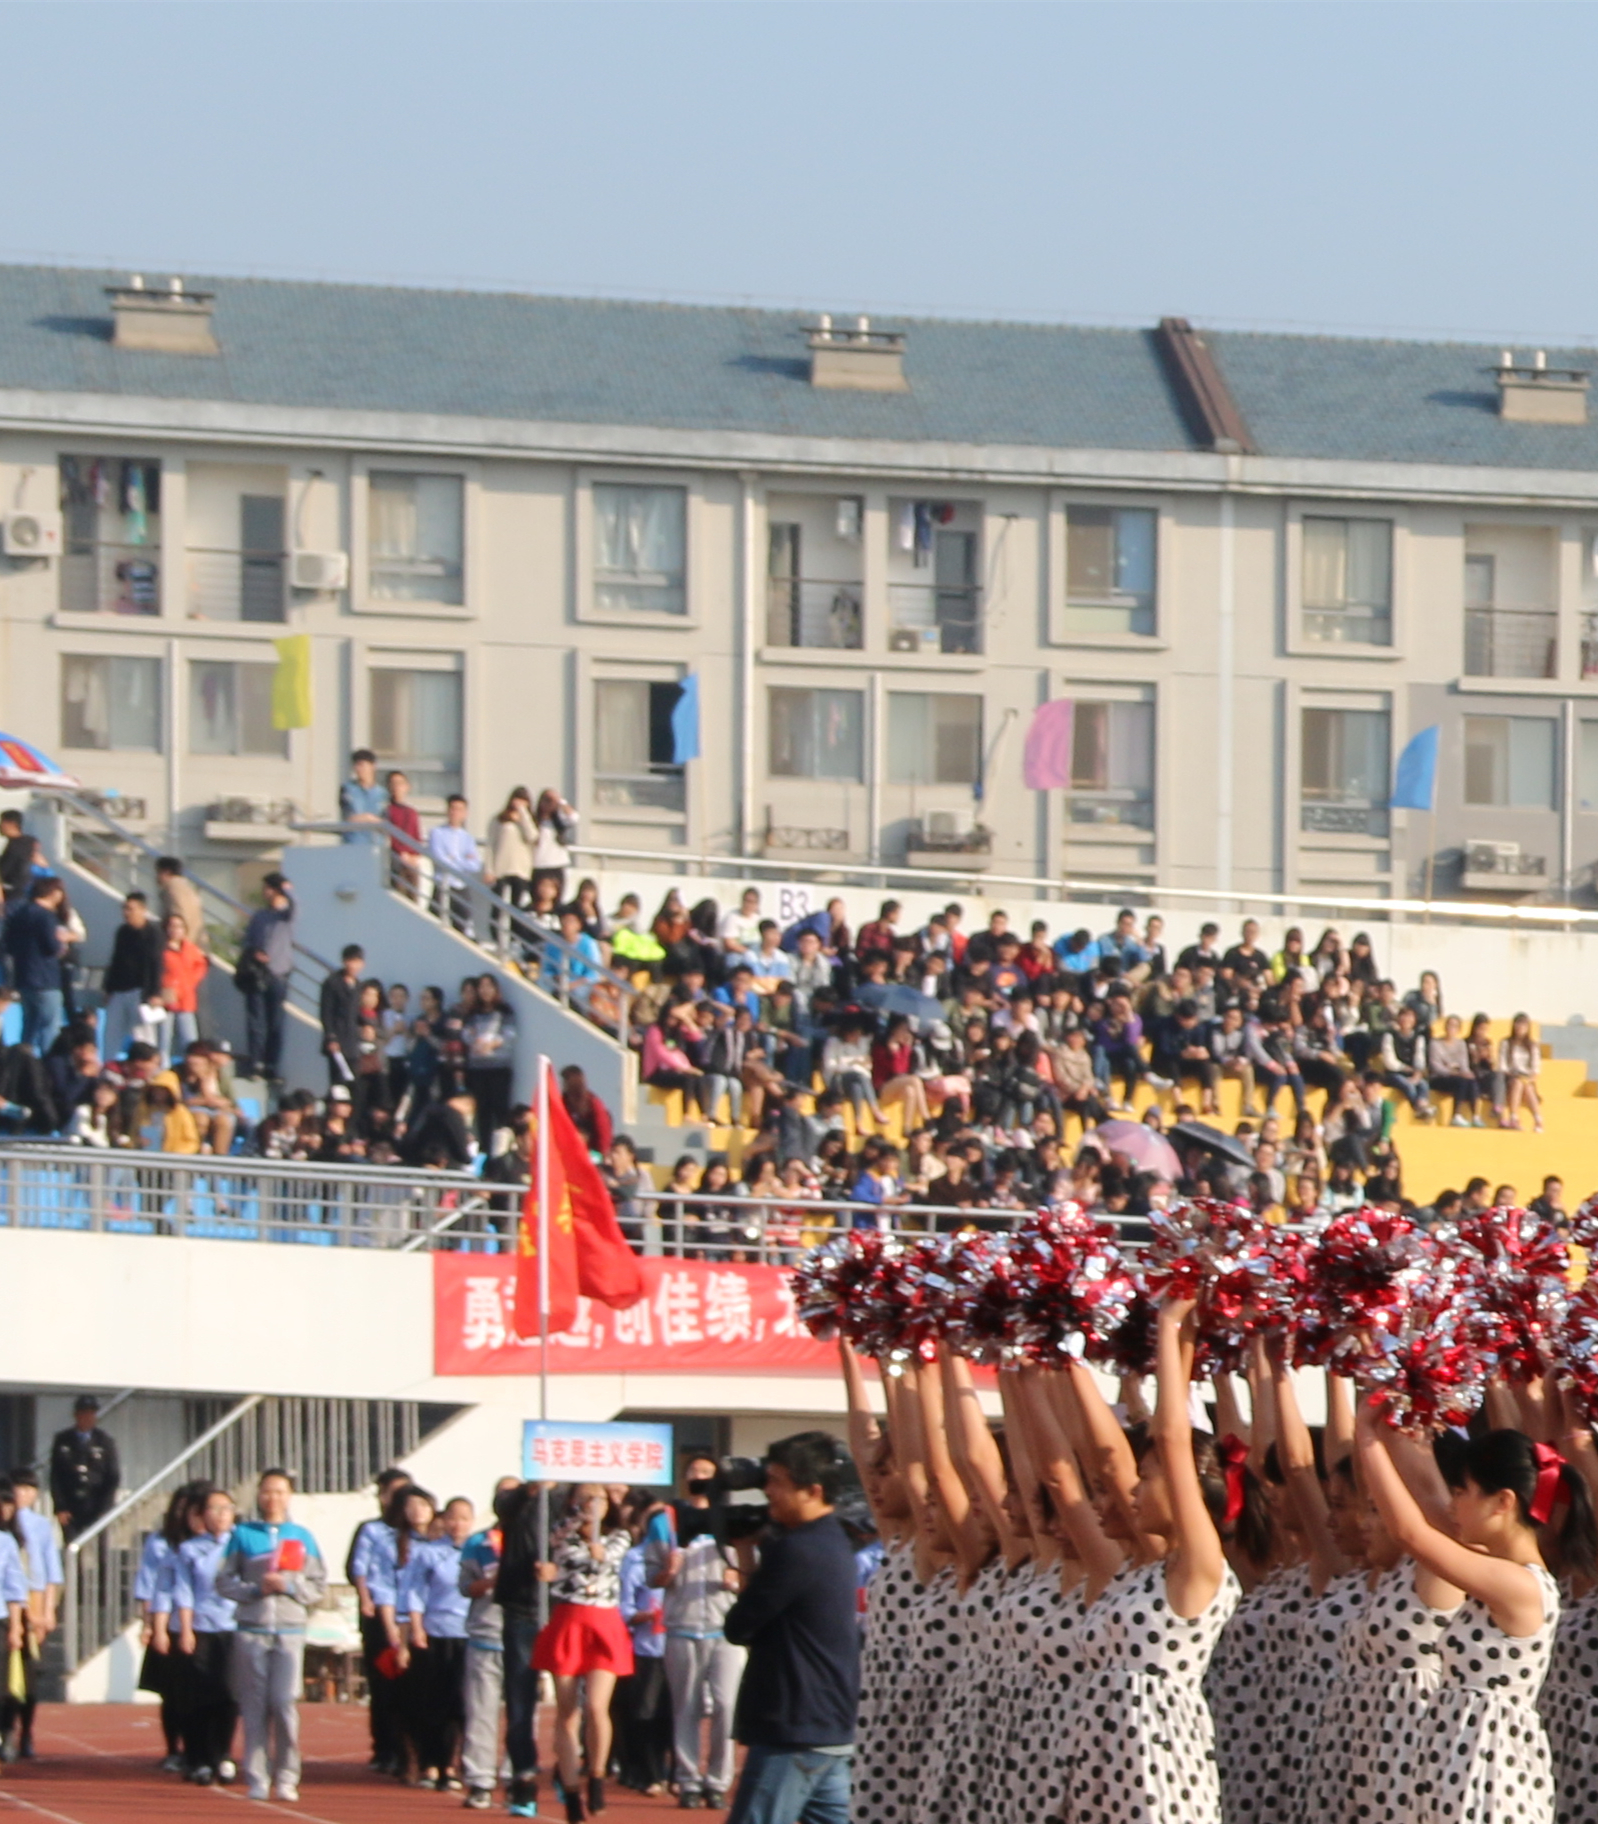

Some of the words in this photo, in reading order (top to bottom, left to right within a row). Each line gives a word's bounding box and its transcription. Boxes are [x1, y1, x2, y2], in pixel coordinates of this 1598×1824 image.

[780, 888, 809, 920] B3
[532, 1438, 663, 1469] 马克思主义学院
